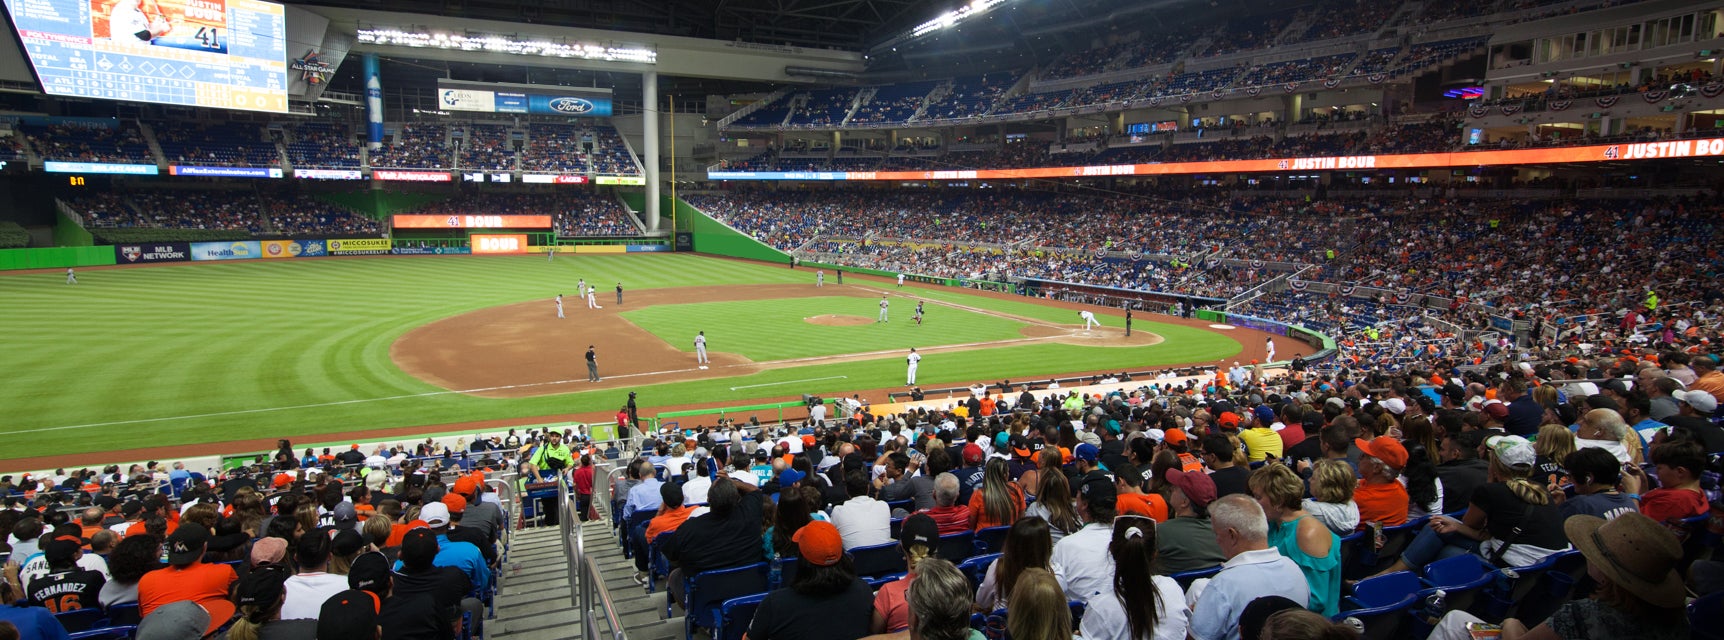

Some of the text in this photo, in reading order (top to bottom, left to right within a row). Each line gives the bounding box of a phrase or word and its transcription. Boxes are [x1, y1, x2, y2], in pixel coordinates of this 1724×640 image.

[184, 7, 222, 21] BOUR
[194, 26, 220, 48] 41
[54, 77, 73, 85] ATL
[235, 94, 247, 106] 0
[255, 95, 267, 107] 0
[557, 101, 586, 112] Ford
[1604, 146, 1619, 158] 41
[1624, 140, 1691, 159] JUSTIN
[1278, 155, 1376, 169] 41 JUSTIN BOUR
[377, 171, 447, 180] Visit Avianca.com
[933, 171, 958, 179] JUSTIN
[958, 170, 977, 178] BOUR
[1083, 166, 1110, 175] JUSTIN
[1111, 164, 1134, 175] BOUR
[560, 175, 583, 183] LAGER
[447, 215, 503, 227] 41 BOUR
[480, 237, 518, 251] BOUR
[143, 251, 185, 260] NETWORK
[207, 248, 249, 257] HealthSun
[34, 582, 87, 601] FERNANDEZ
[44, 593, 82, 614] 16
